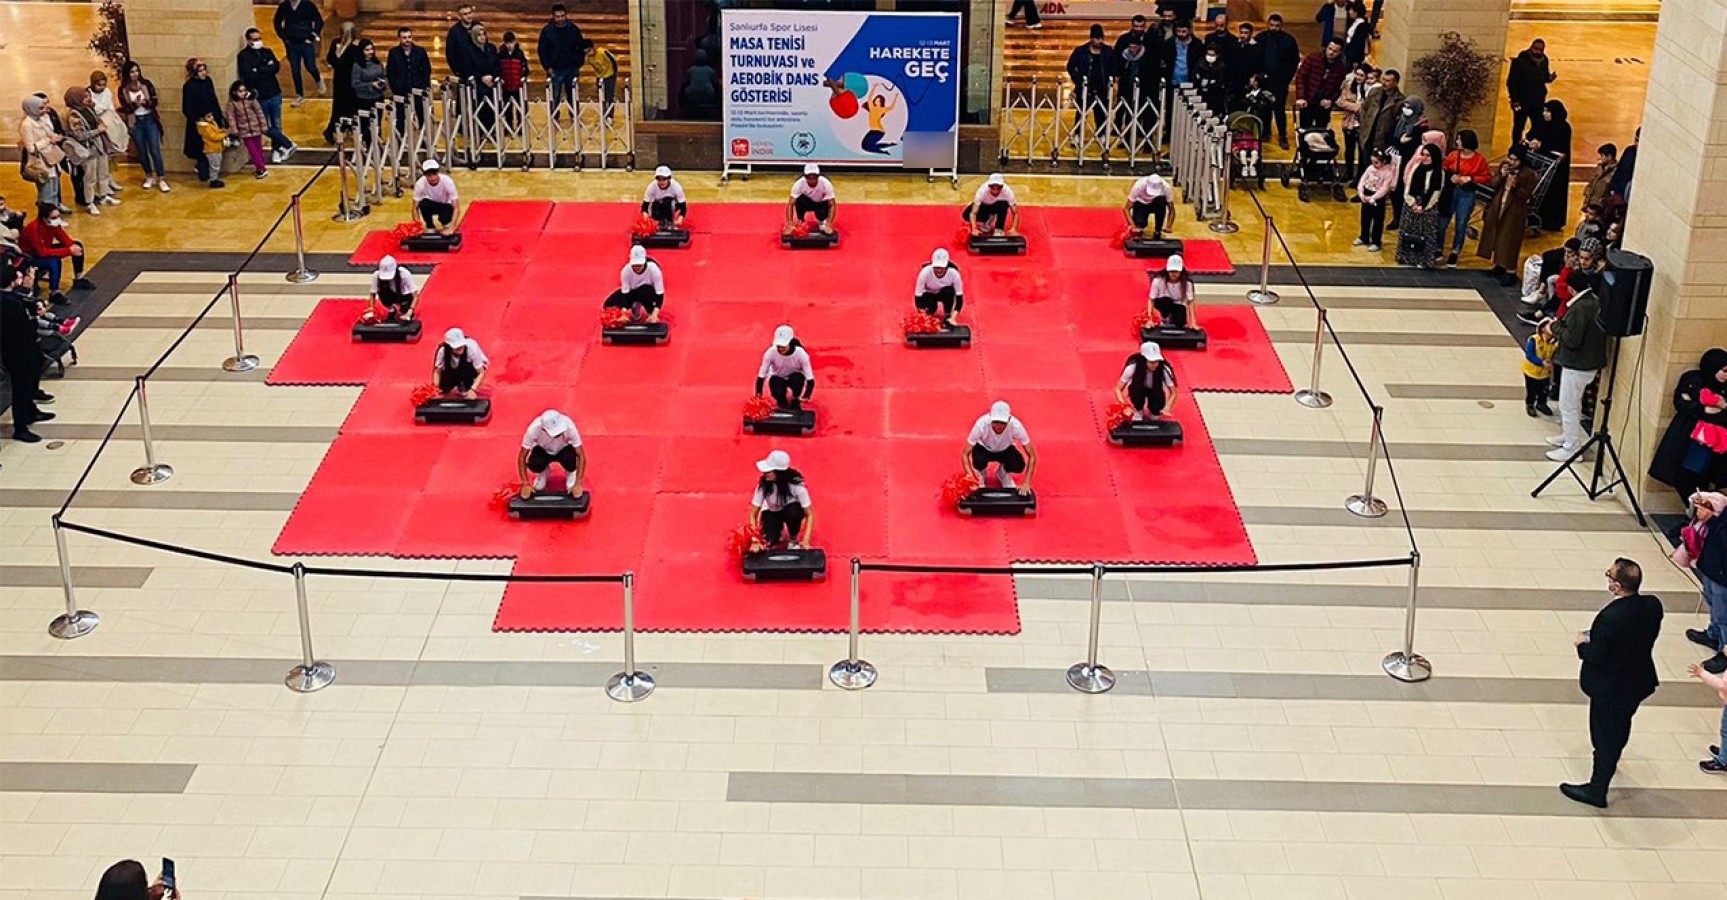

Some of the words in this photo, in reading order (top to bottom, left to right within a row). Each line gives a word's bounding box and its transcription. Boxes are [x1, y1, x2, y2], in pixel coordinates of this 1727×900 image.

[770, 22, 791, 32] Spor
[793, 23, 818, 32] Lisesi
[730, 37, 764, 50] MASA
[767, 35, 805, 50] TENİSİ
[869, 46, 950, 59] HAREKETE
[730, 55, 798, 68] TURNUVASI
[801, 57, 815, 68] ve
[730, 70, 783, 85] AEROBİK
[786, 73, 819, 85] DANS
[904, 60, 950, 83] GEÇ
[730, 87, 792, 103] GÖSTERİSİ
